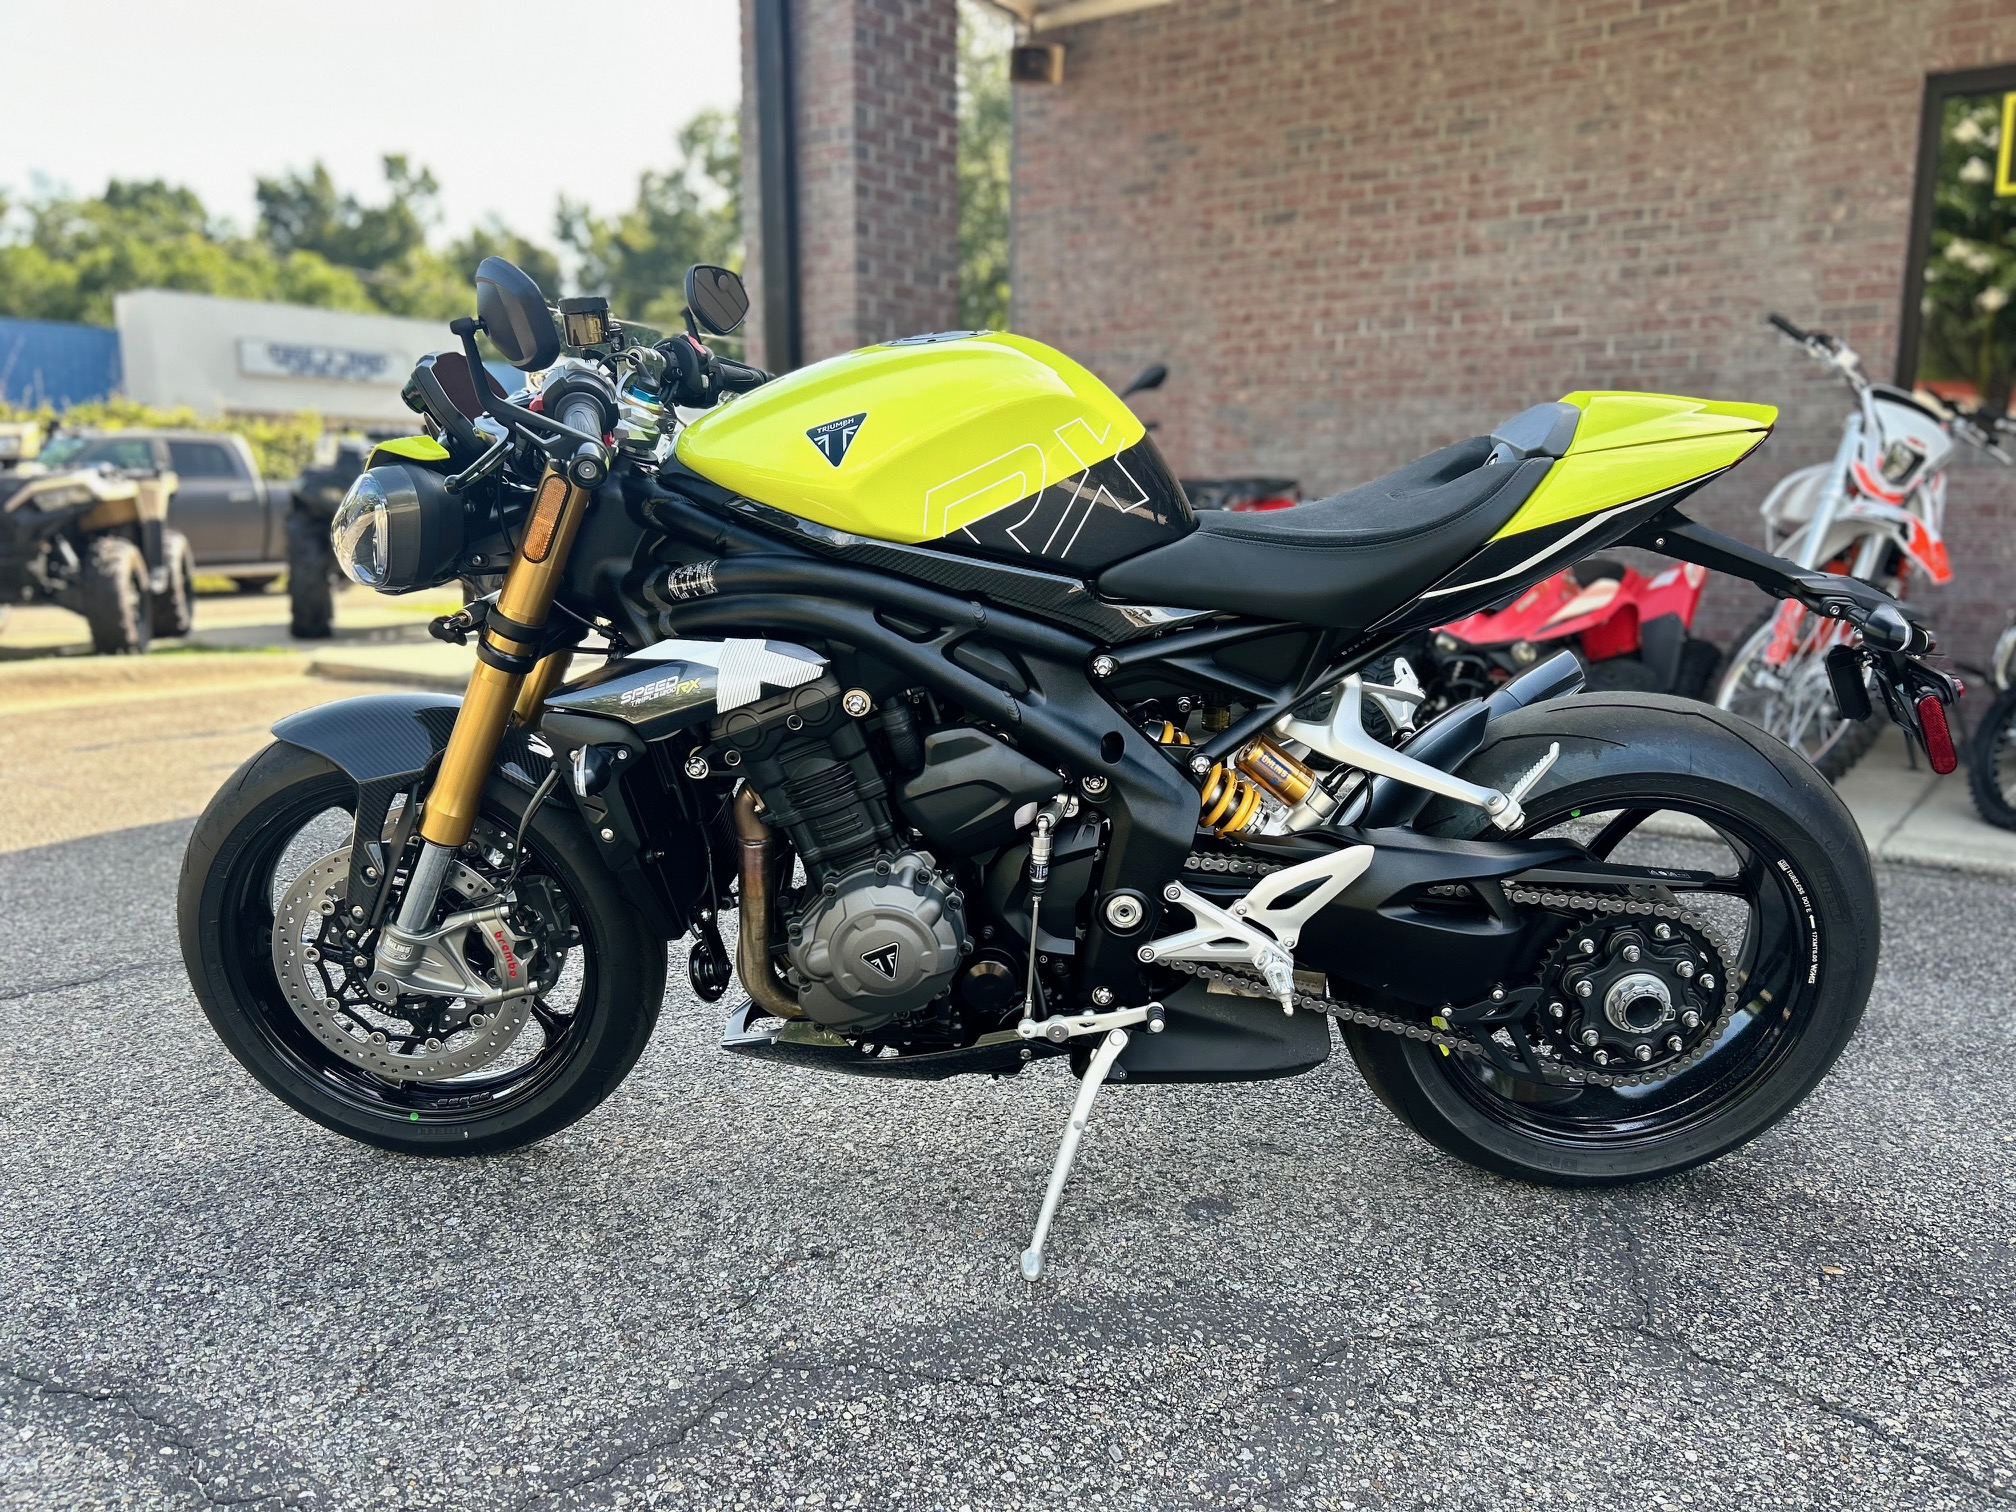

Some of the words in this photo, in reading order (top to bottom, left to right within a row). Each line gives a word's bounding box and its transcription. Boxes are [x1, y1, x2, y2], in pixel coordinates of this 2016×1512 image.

[817, 417, 855, 434] TRIUMPH
[922, 416, 1150, 558] RX
[620, 675, 680, 705] SPEED
[676, 678, 701, 695] RX
[1787, 869, 1805, 895] TUBELESS
[1802, 896, 1811, 908] DOT
[494, 930, 518, 977] brembo
